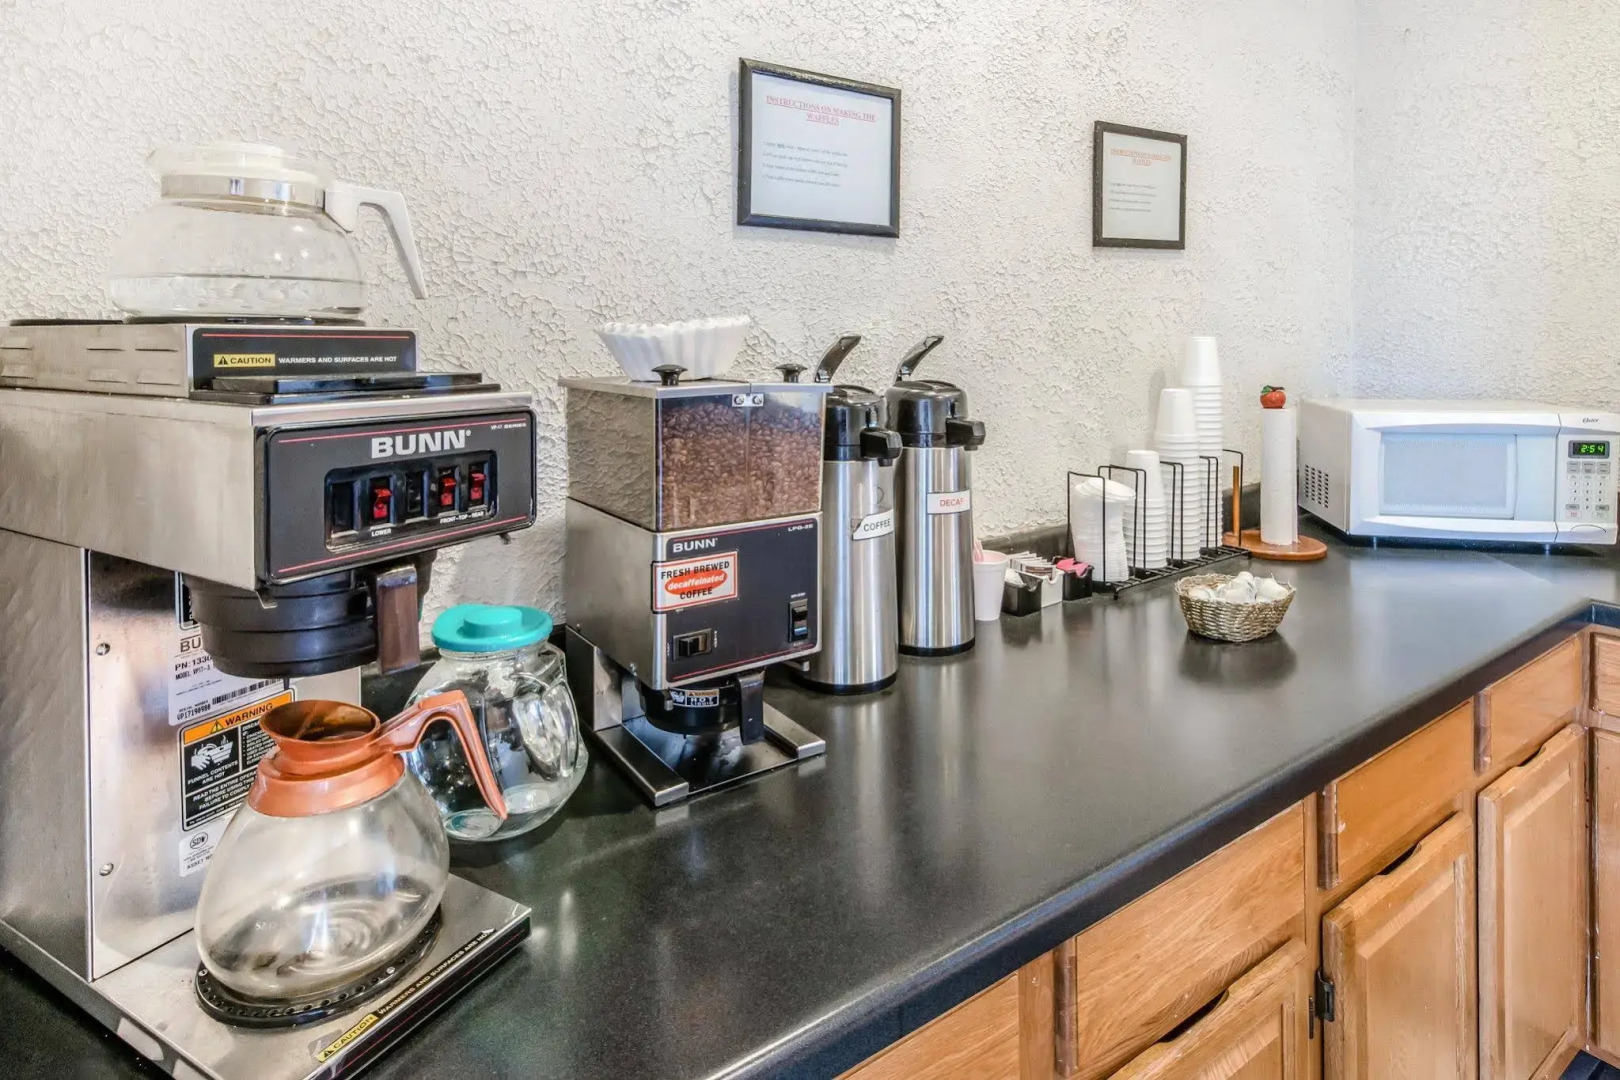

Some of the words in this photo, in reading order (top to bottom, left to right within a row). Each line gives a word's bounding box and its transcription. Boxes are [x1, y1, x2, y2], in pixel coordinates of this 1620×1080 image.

[766, 95, 820, 111] INSTRUCTIONS
[821, 105, 831, 113] ON
[832, 106, 861, 119] MAKING
[862, 112, 876, 122] THE
[807, 112, 840, 125] WAFFLES
[230, 357, 271, 365] CAUTION
[278, 356, 316, 364] WARMERS
[371, 429, 466, 459] BUNN
[1580, 444, 1604, 453] 2:54
[939, 499, 965, 507] DECAF
[371, 528, 391, 537] LOWER
[863, 518, 891, 532] COFFEE
[672, 537, 716, 553] BUNN
[660, 567, 691, 579] FRESH
[693, 560, 730, 574] BREWED
[667, 572, 725, 591] decaffeinated
[680, 586, 713, 599] COFFEE
[225, 702, 273, 726] WARNING
[187, 772, 209, 785] FUNNEL
[210, 759, 238, 775] CONTENTS
[202, 775, 214, 785] ARE
[214, 770, 225, 779] HOT
[193, 790, 208, 802] READ
[209, 787, 219, 796] THE
[220, 778, 239, 791] ENTIRE
[199, 796, 221, 810] FAILURE
[222, 792, 229, 800] TO
[230, 784, 250, 797] COMPLY
[204, 788, 226, 802] BEFORE
[227, 782, 243, 792] USING
[333, 1015, 374, 1049] CAUTION
[378, 987, 416, 1015] WARMERS
[416, 976, 431, 988] AND
[430, 950, 465, 977] SURFACES
[464, 940, 478, 951] ARE
